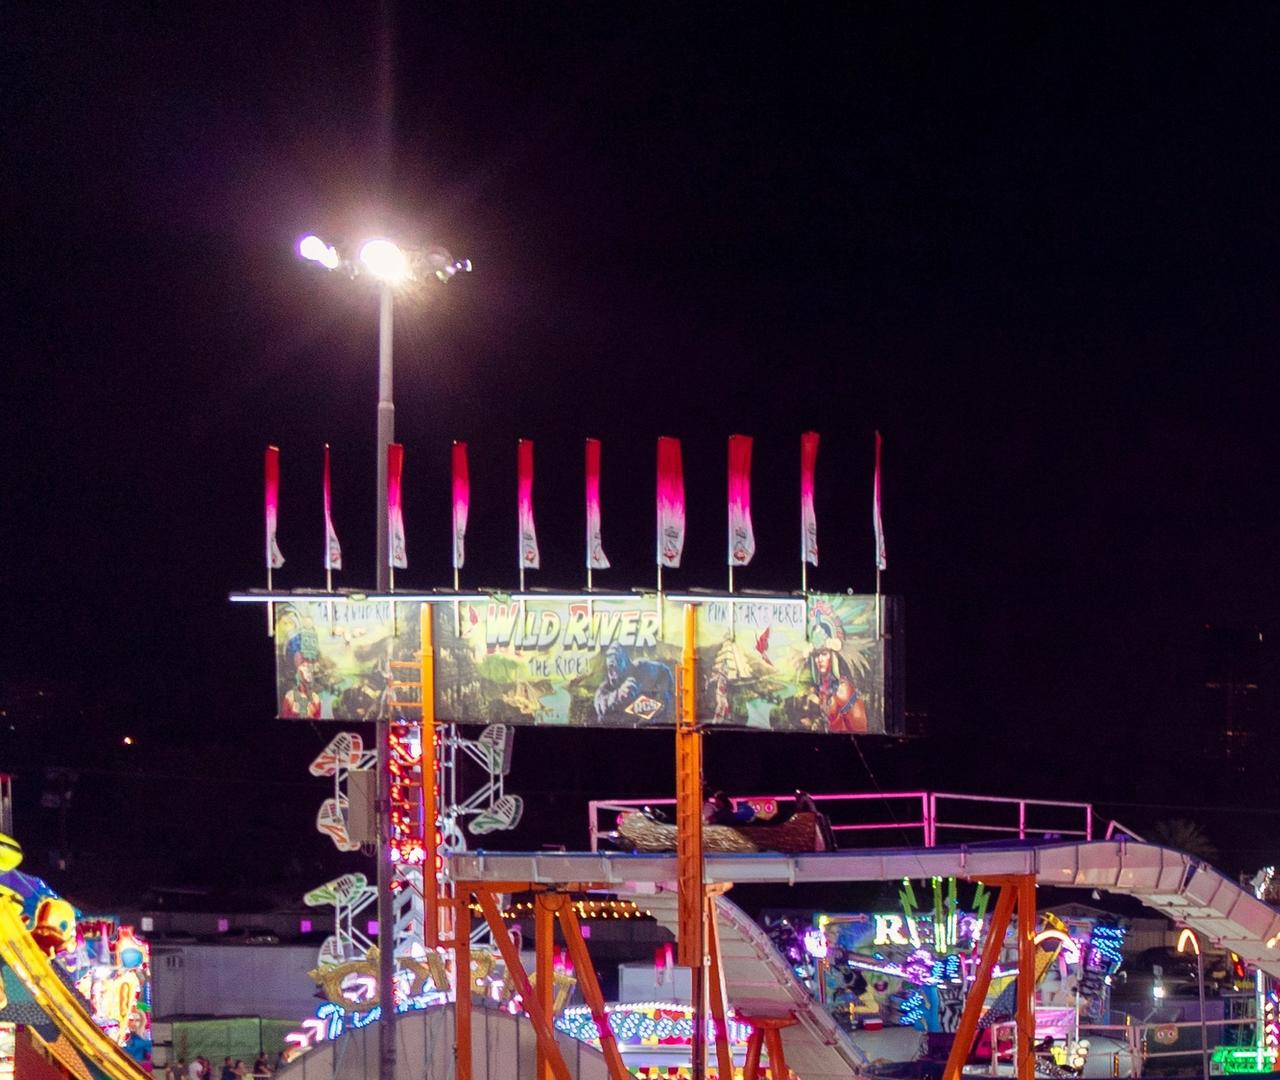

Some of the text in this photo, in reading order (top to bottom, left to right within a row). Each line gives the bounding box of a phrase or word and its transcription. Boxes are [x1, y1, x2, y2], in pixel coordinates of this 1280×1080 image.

[486, 602, 660, 652] WILD RIVER
[528, 656, 550, 677] THE
